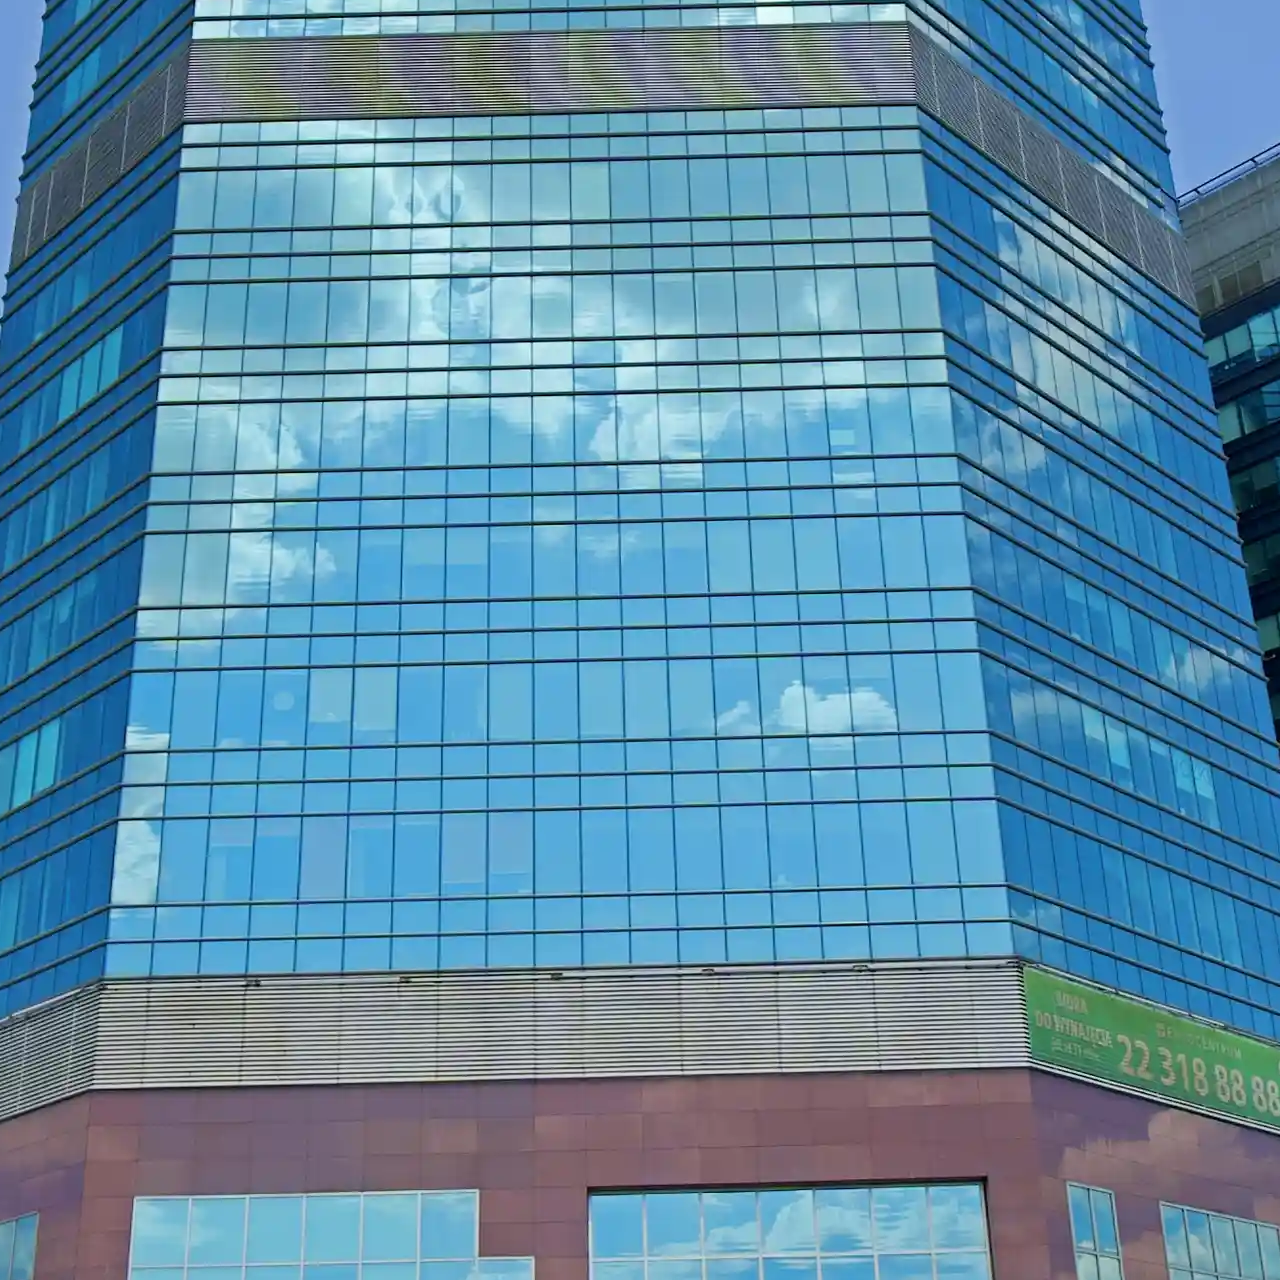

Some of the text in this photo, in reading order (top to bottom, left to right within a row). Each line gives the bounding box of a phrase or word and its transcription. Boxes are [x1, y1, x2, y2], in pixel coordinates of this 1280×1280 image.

[1035, 1010, 1052, 1029] DO
[1117, 1034, 1153, 1081] 22
[1158, 1046, 1209, 1097] 318
[1214, 1064, 1247, 1108] 88
